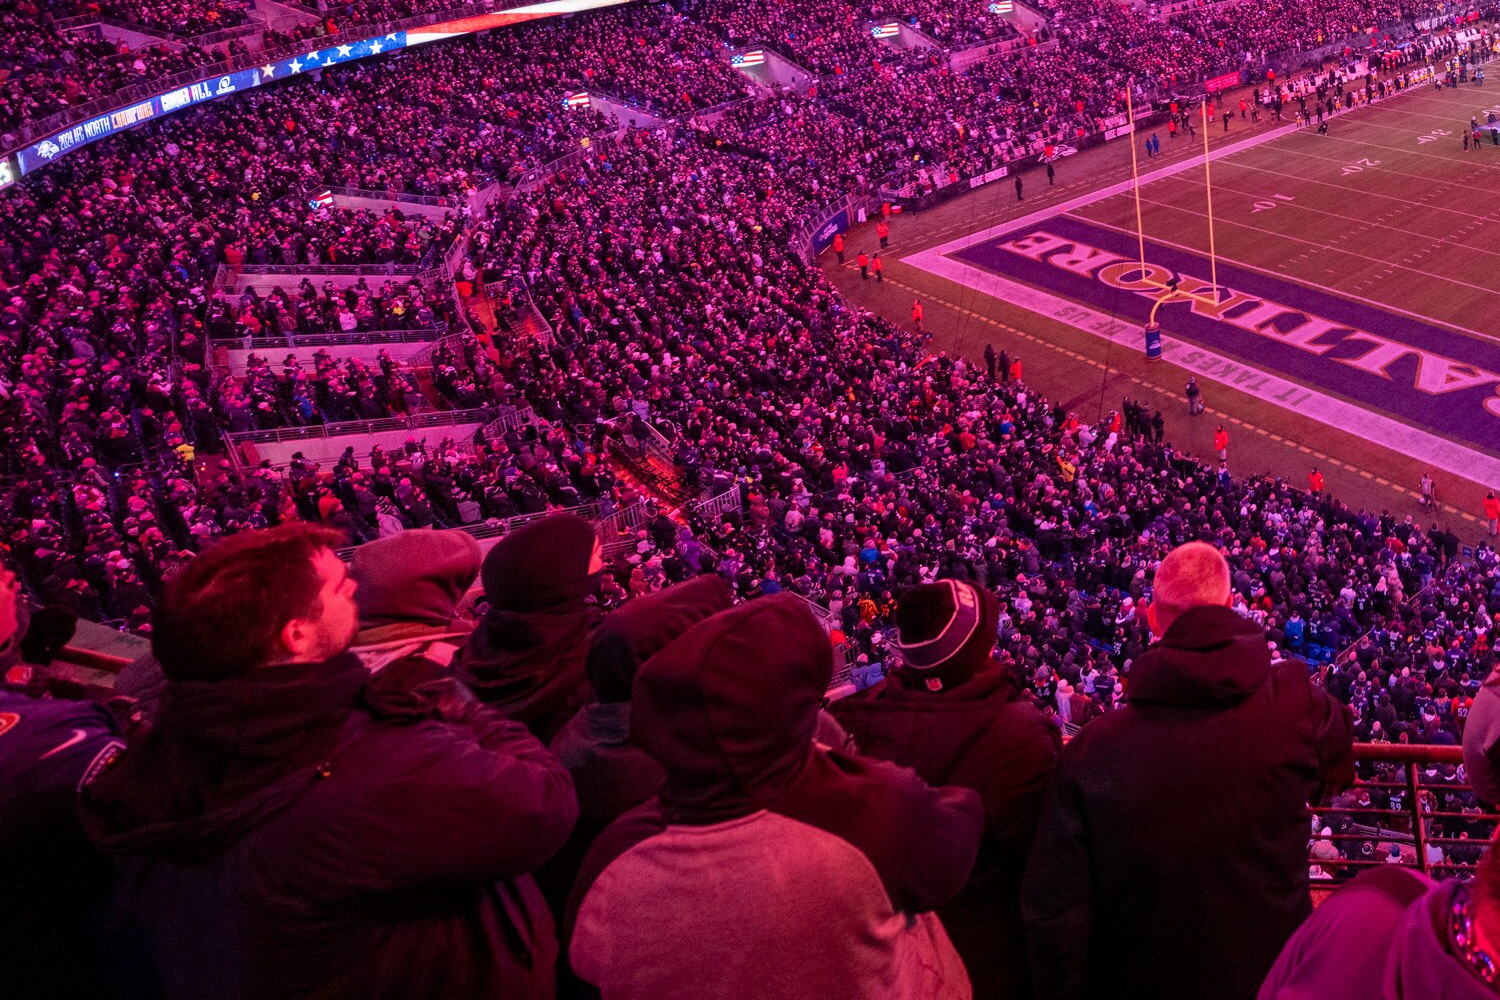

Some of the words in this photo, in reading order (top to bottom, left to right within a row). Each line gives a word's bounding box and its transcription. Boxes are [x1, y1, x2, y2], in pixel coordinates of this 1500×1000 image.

[84, 116, 110, 138] NORTH
[1418, 129, 1453, 143] 30
[1342, 157, 1381, 174] 20
[1253, 193, 1295, 211] 10
[1052, 304, 1092, 326] US
[1094, 318, 1129, 337] OF
[1180, 350, 1271, 392] TAKES
[1273, 388, 1312, 408] IT
[1458, 707, 1468, 717] 52
